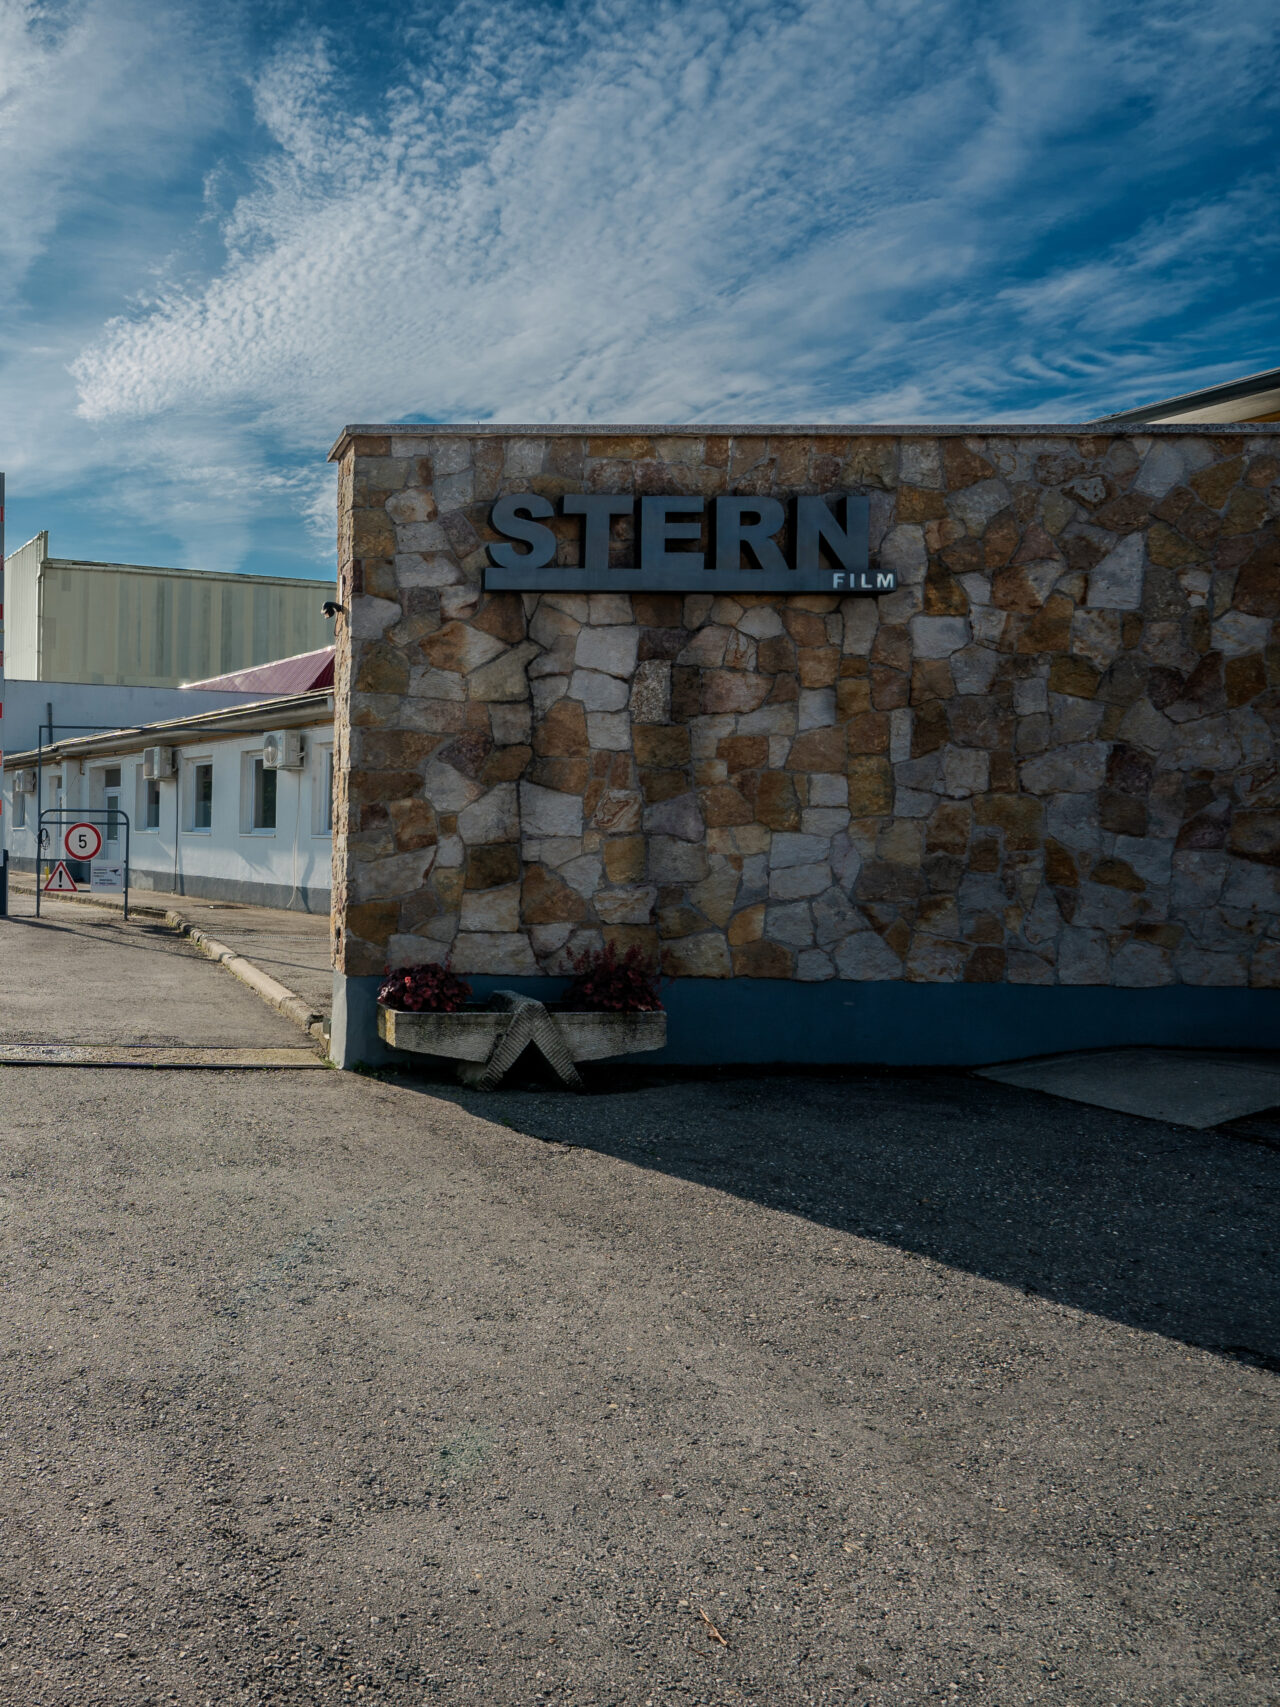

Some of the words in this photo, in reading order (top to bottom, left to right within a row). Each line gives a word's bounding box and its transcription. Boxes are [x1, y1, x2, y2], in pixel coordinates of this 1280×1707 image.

[487, 494, 870, 569] STERN
[832, 572, 894, 589] FILM
[78, 834, 87, 849] 5
